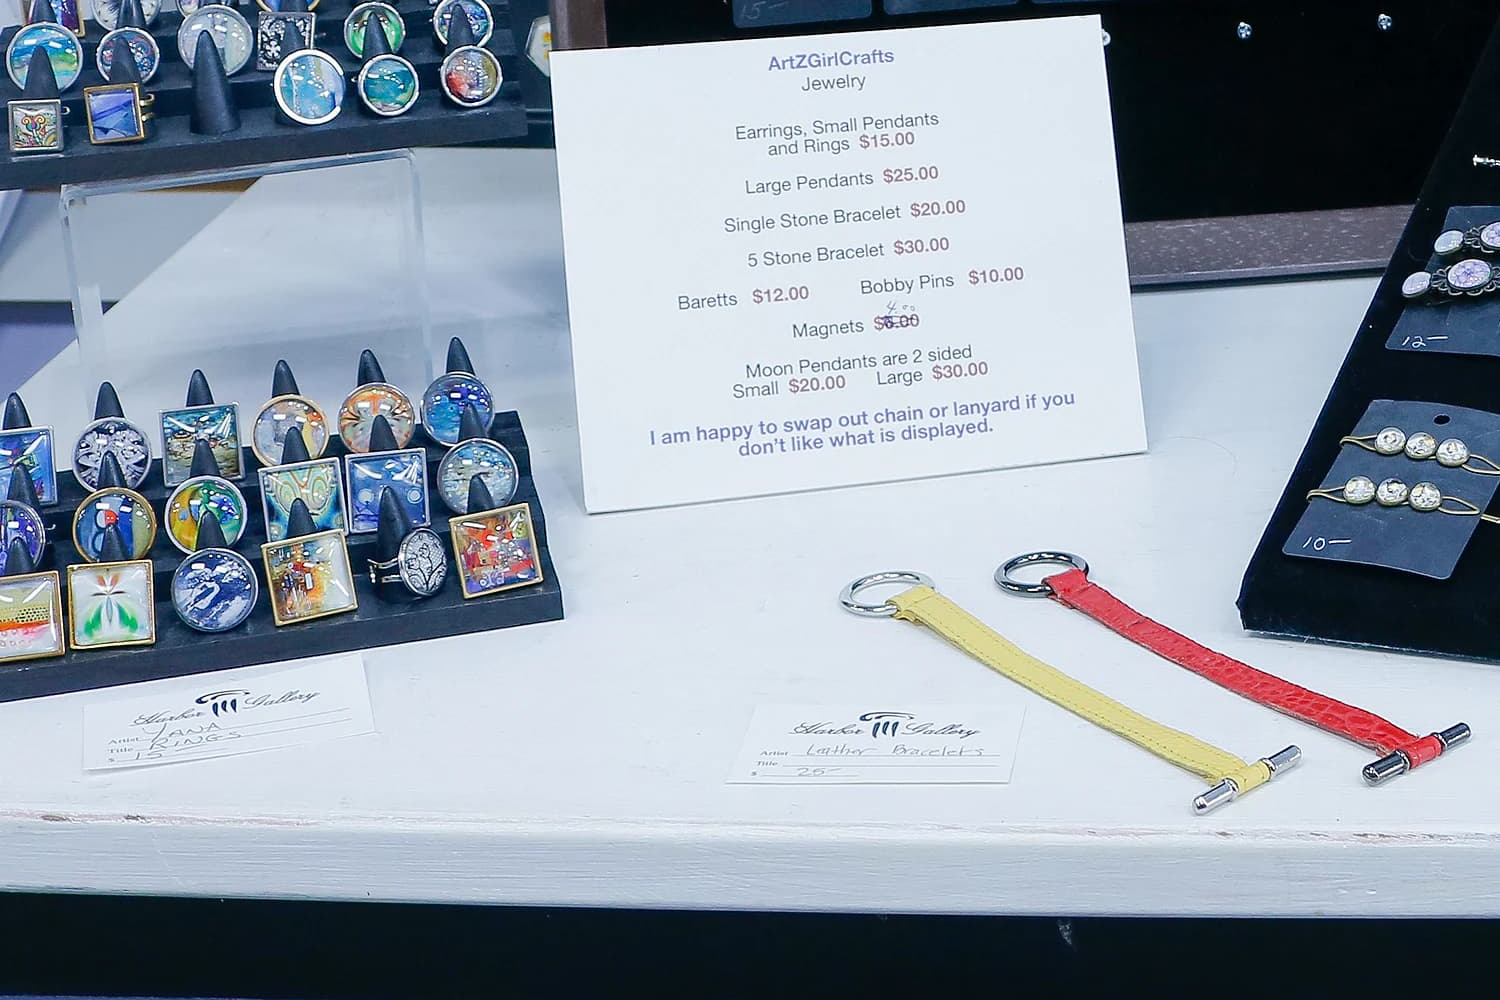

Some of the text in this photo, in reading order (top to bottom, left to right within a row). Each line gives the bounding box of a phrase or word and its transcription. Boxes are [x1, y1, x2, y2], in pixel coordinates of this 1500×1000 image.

[768, 48, 895, 72] ArtZGirlCrafts
[801, 73, 867, 92] Jewelry
[735, 112, 940, 141] Earrings, Small Pendants
[767, 131, 915, 157] and Rings $15.00
[745, 165, 939, 196] Large Pendants $25.00
[724, 199, 966, 235] Single Stone Bracelet $20.00
[747, 236, 950, 268] 5 Stone Bracelet $30.00
[677, 266, 1024, 311] Baretts $12.00 Bobby Pins $10.00
[792, 319, 865, 340] Magnets
[745, 343, 973, 379] Moon Pendants are 2 sided
[732, 360, 989, 399] Small $20.00 Large $30.00
[649, 393, 1076, 446] I am happy to swap out chain or lanyard if you
[738, 417, 994, 457] don't like what is displayed.
[129, 689, 321, 728] Harbor Gallery
[788, 721, 982, 739] Harbor Gallery
[135, 751, 163, 761] 15
